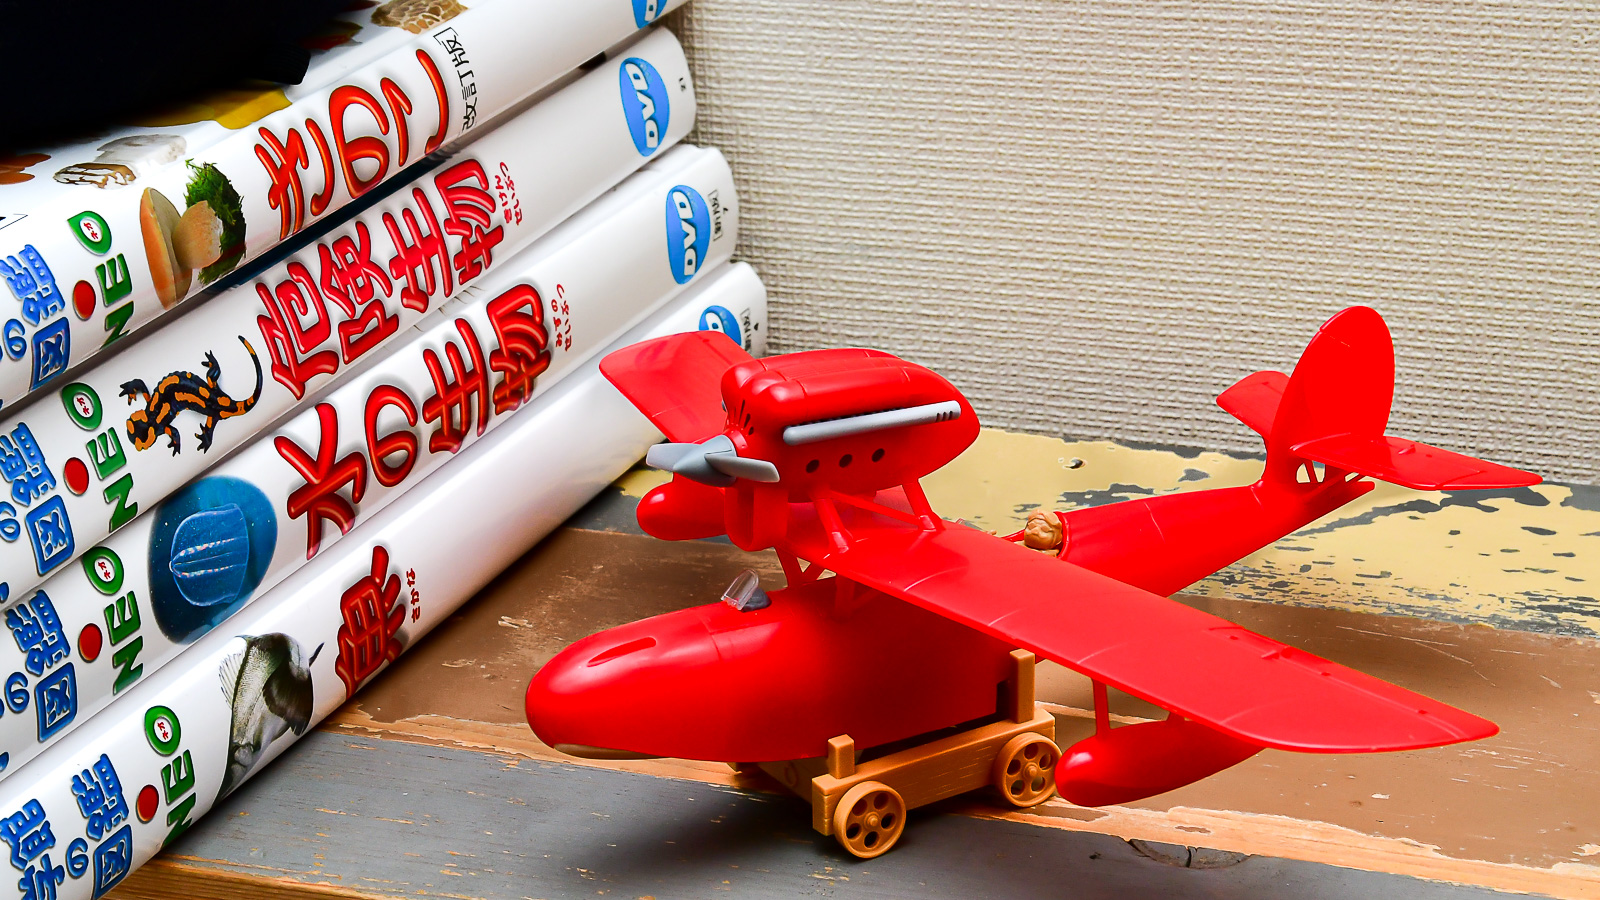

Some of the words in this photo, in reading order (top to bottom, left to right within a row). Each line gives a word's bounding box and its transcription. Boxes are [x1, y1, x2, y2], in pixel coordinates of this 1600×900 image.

[254, 49, 449, 240] きのこ
[625, 63, 659, 148] DVD
[500, 162, 523, 226] せいぶつ
[672, 191, 697, 276] DVD
[256, 159, 503, 400] 危険生物
[556, 283, 573, 352] せいぶつ
[61, 382, 138, 533] NEO
[274, 284, 551, 560] 水の生物
[82, 546, 143, 696] NEO
[335, 545, 407, 700] 魚
[406, 568, 421, 623] さかな
[144, 705, 196, 850] NEO
